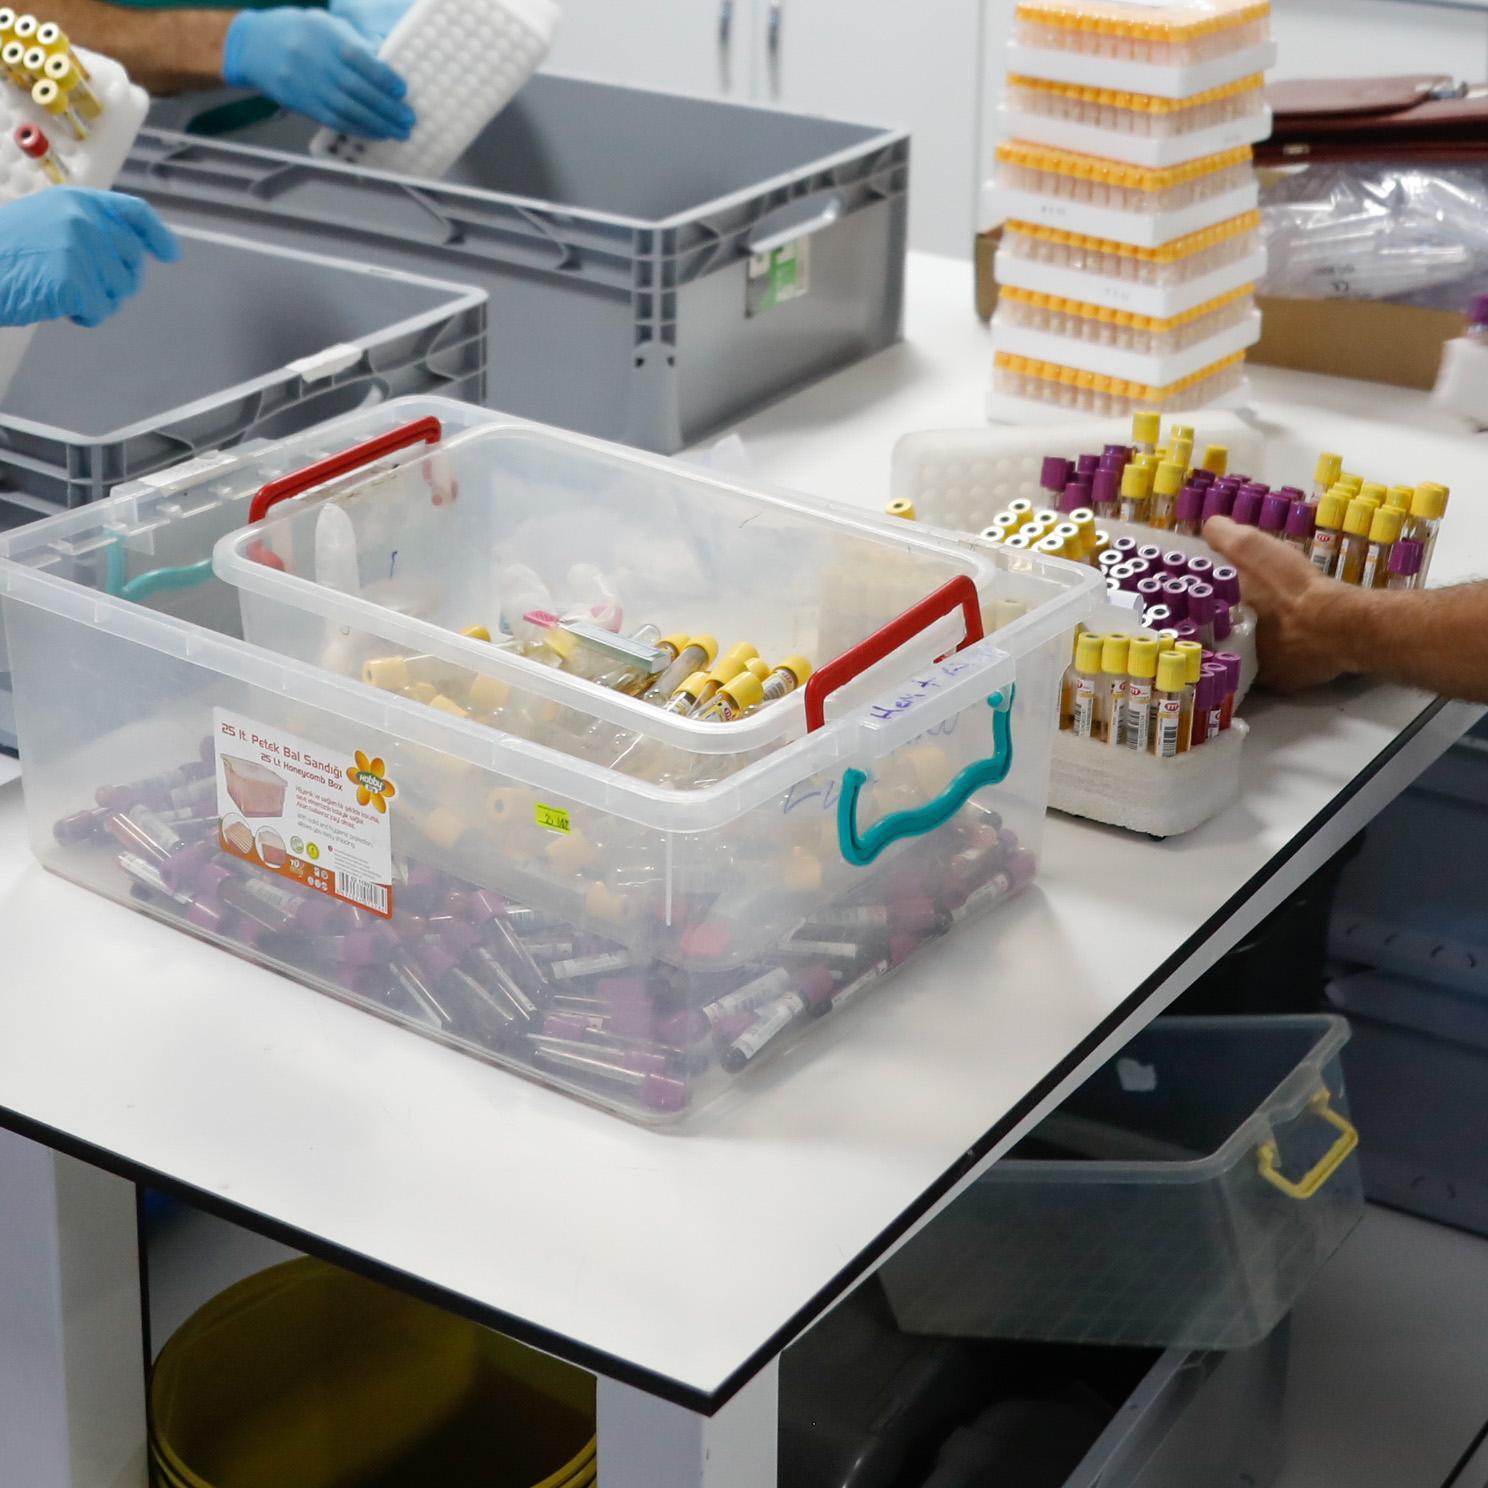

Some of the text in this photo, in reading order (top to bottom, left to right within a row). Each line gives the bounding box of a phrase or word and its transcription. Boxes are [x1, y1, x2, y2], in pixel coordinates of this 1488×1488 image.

[221, 722, 236, 737] 25
[251, 734, 279, 753] Petek
[283, 745, 300, 762] Bal
[304, 754, 343, 779] Sandığı
[260, 752, 272, 763] 25
[283, 761, 326, 785] Honeycomb
[327, 779, 343, 792] Box
